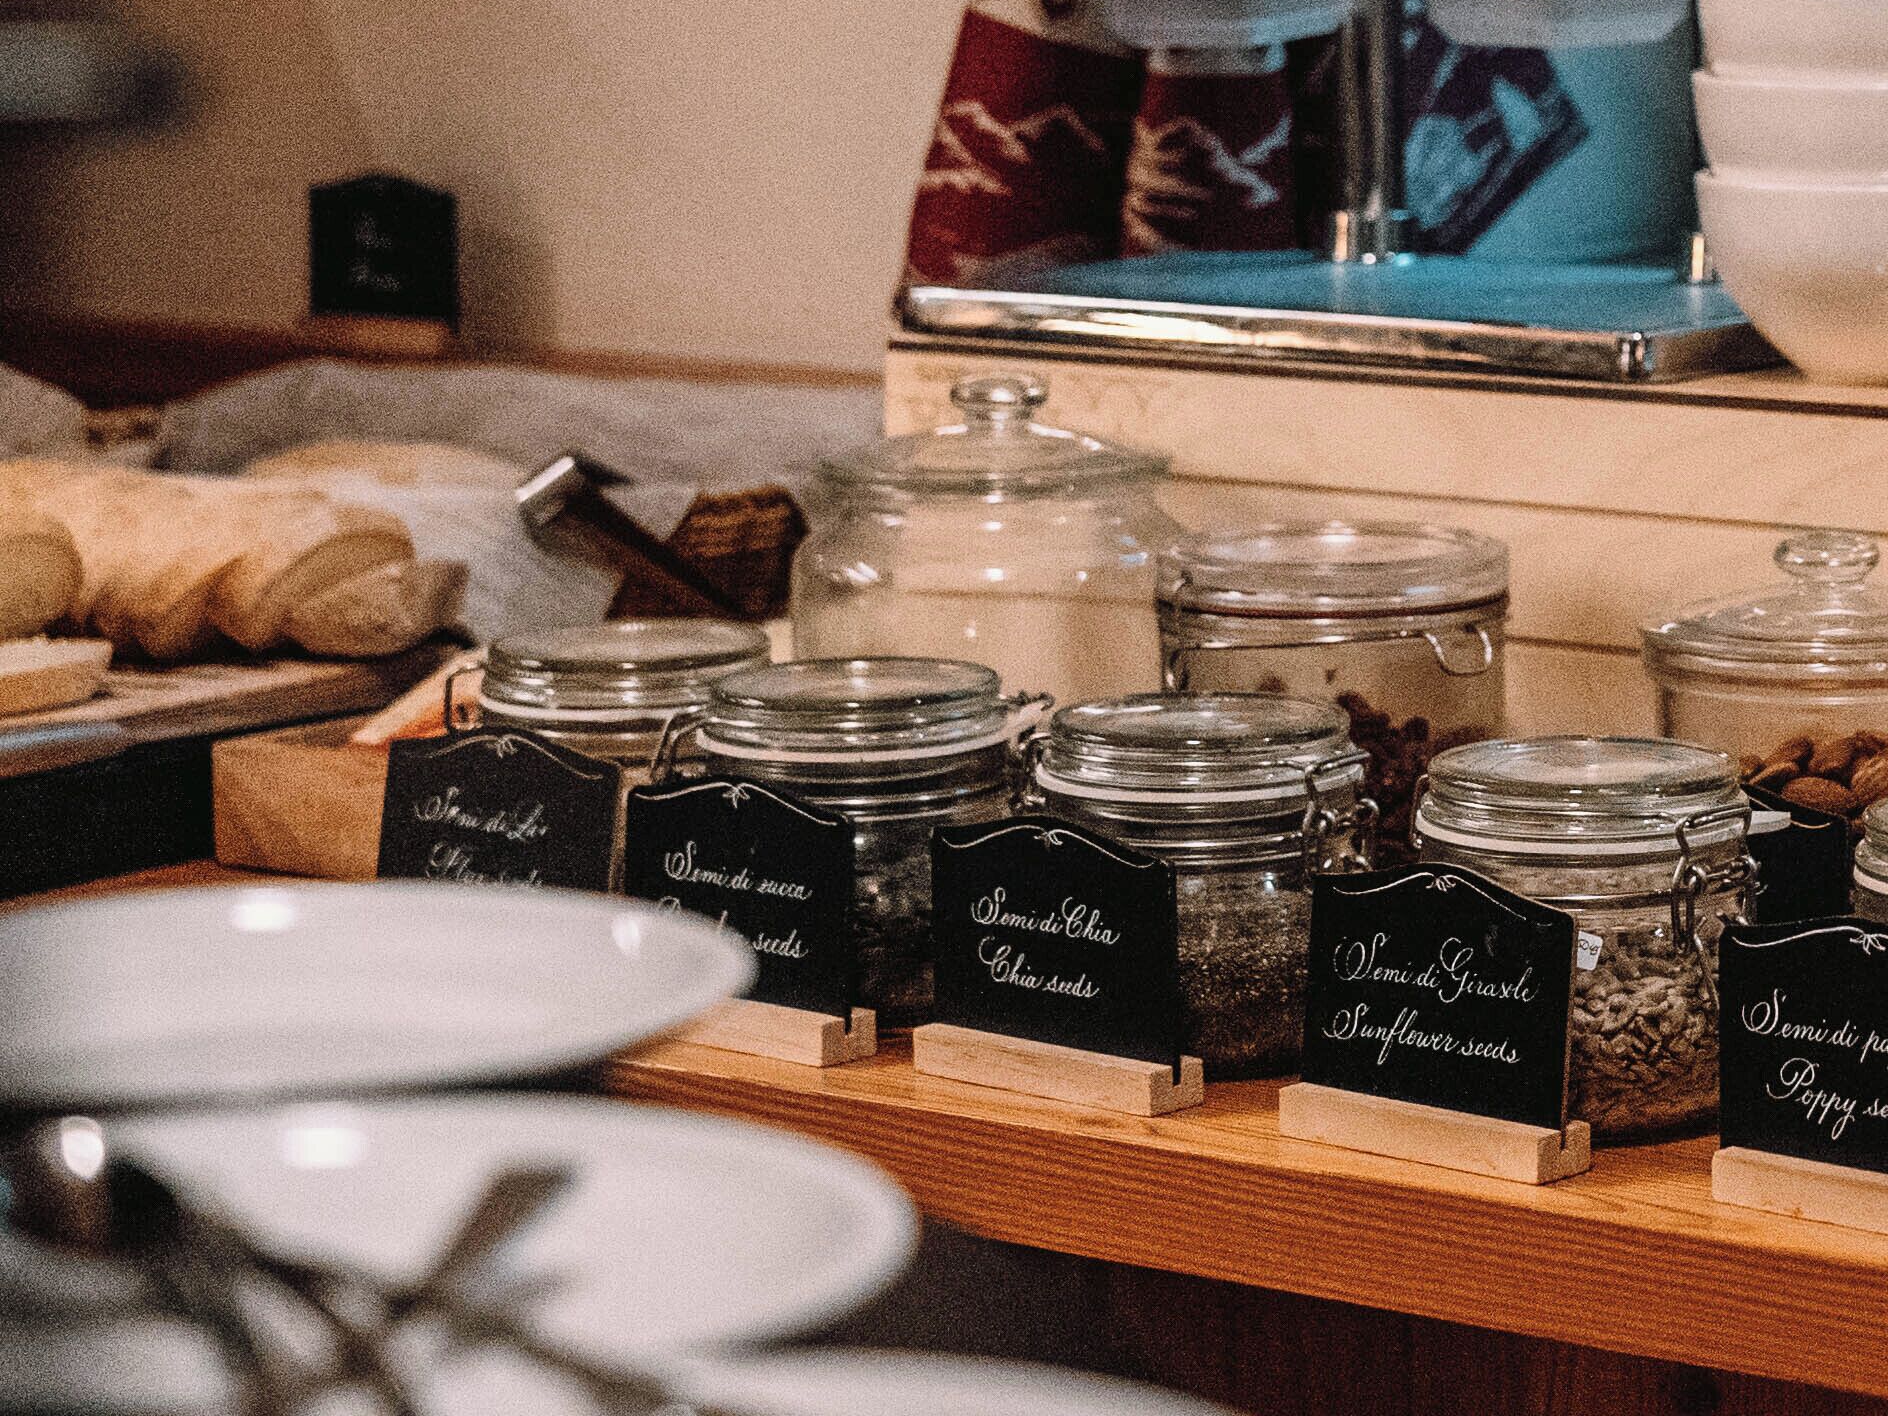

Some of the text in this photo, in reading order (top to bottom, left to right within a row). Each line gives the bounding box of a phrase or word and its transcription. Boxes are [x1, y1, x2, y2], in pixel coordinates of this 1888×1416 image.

[665, 840, 814, 901] Semi di zucca
[752, 928, 810, 959] seeds
[971, 886, 1121, 945] Semi di Chia
[978, 935, 1100, 999] Chia seeds
[1333, 932, 1413, 984] Semi
[1413, 962, 1441, 990] di
[1322, 1002, 1521, 1065] Sunflower seeds
[1741, 988, 1829, 1043] Semi
[1829, 1019, 1861, 1048] di
[1766, 1057, 1857, 1141] Poppy
